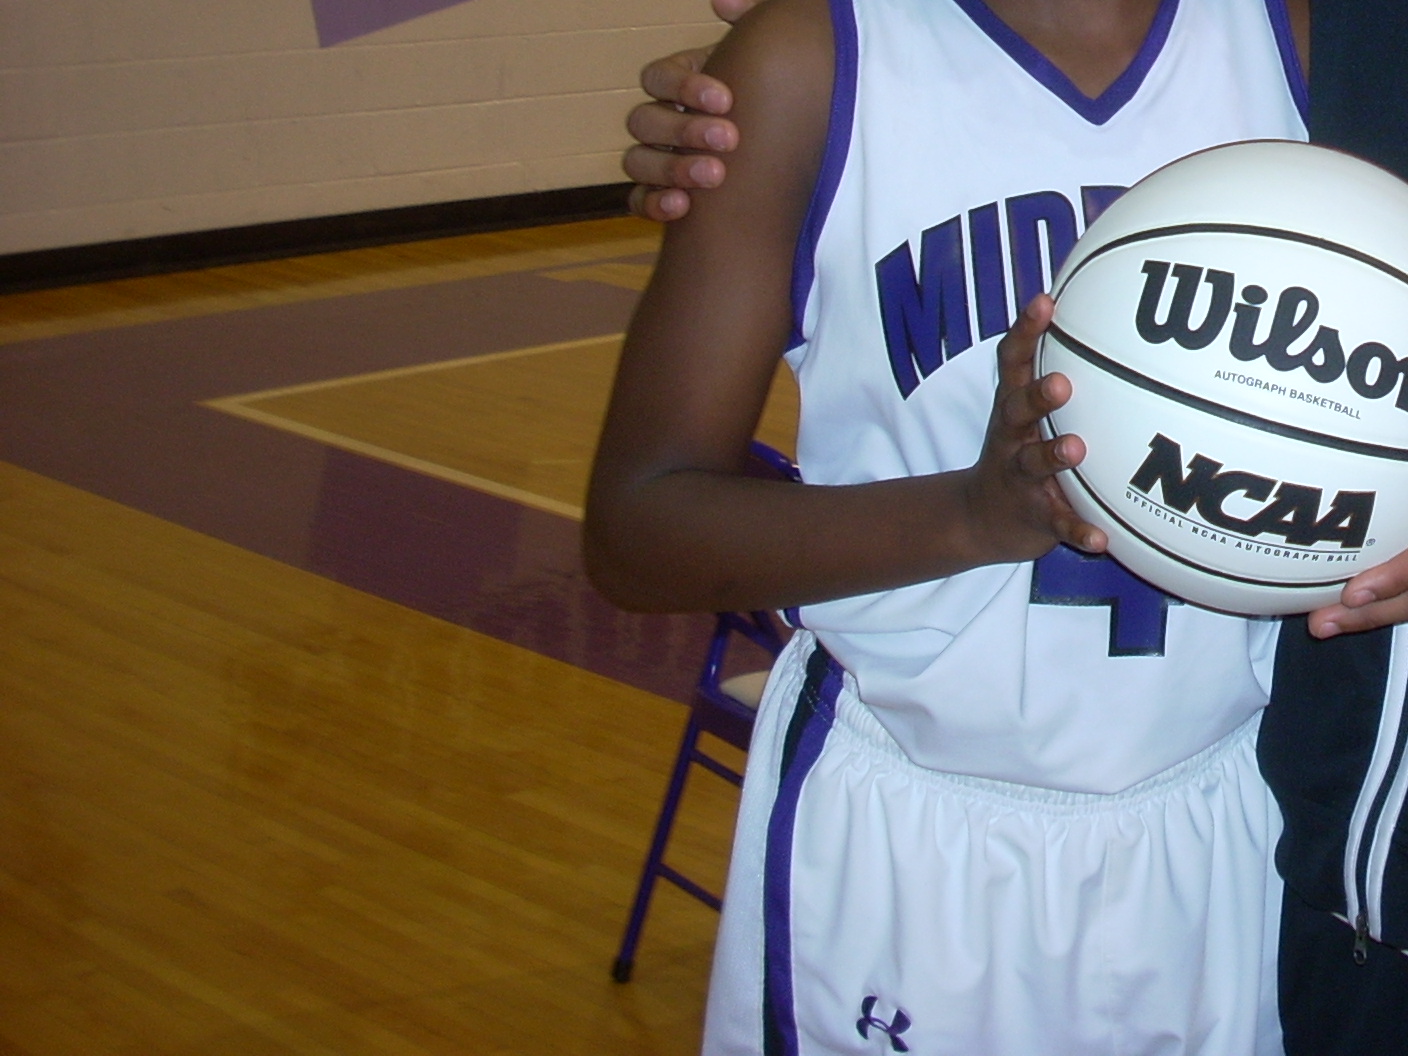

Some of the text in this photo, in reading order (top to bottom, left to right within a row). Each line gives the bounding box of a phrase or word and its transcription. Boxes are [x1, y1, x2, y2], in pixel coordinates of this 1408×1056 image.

[1213, 369, 1362, 420] AUTOGRAPH BASKETBALL
[1125, 490, 1359, 563] OFFICIAL NCAA AUTOGRAPH BALL
[1128, 432, 1377, 549] NCAA
